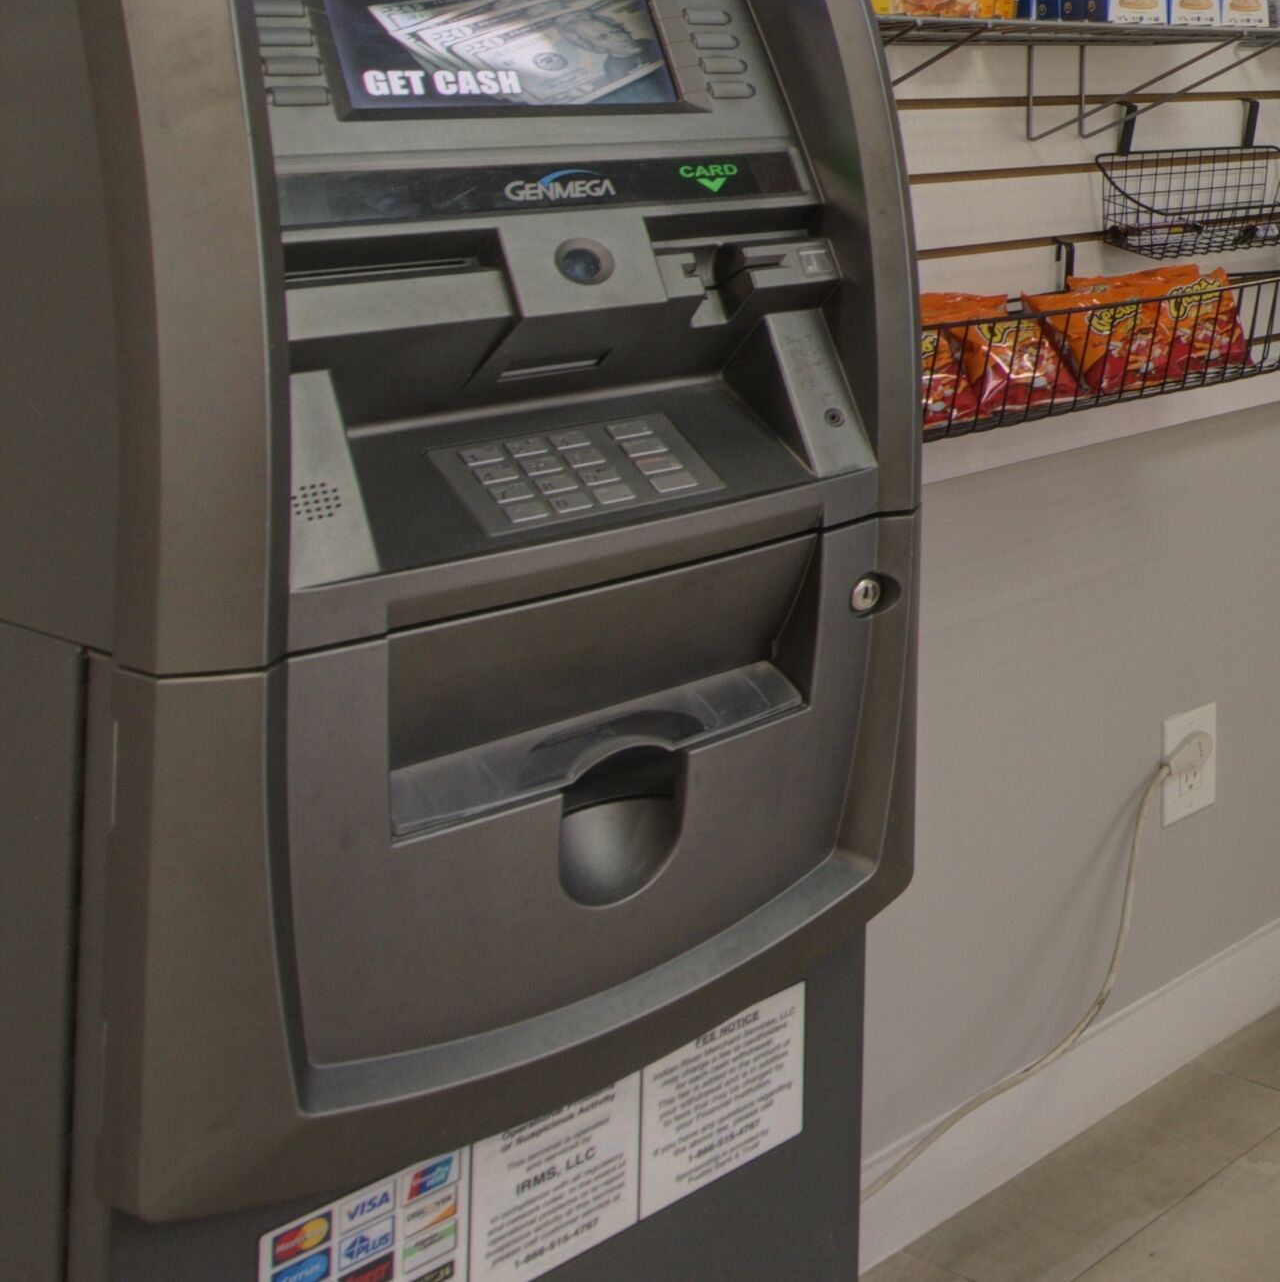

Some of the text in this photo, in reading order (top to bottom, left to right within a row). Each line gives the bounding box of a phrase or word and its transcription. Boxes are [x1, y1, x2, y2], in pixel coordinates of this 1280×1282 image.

[362, 69, 426, 97] GET
[432, 69, 523, 96] CASH
[678, 164, 739, 178] CARD
[504, 178, 617, 202] GENMEGA
[720, 1010, 761, 1039] NOTICE
[515, 1146, 597, 1196] IRMS, LLC
[346, 1190, 390, 1223] VISA
[355, 1232, 391, 1260] PLUS
